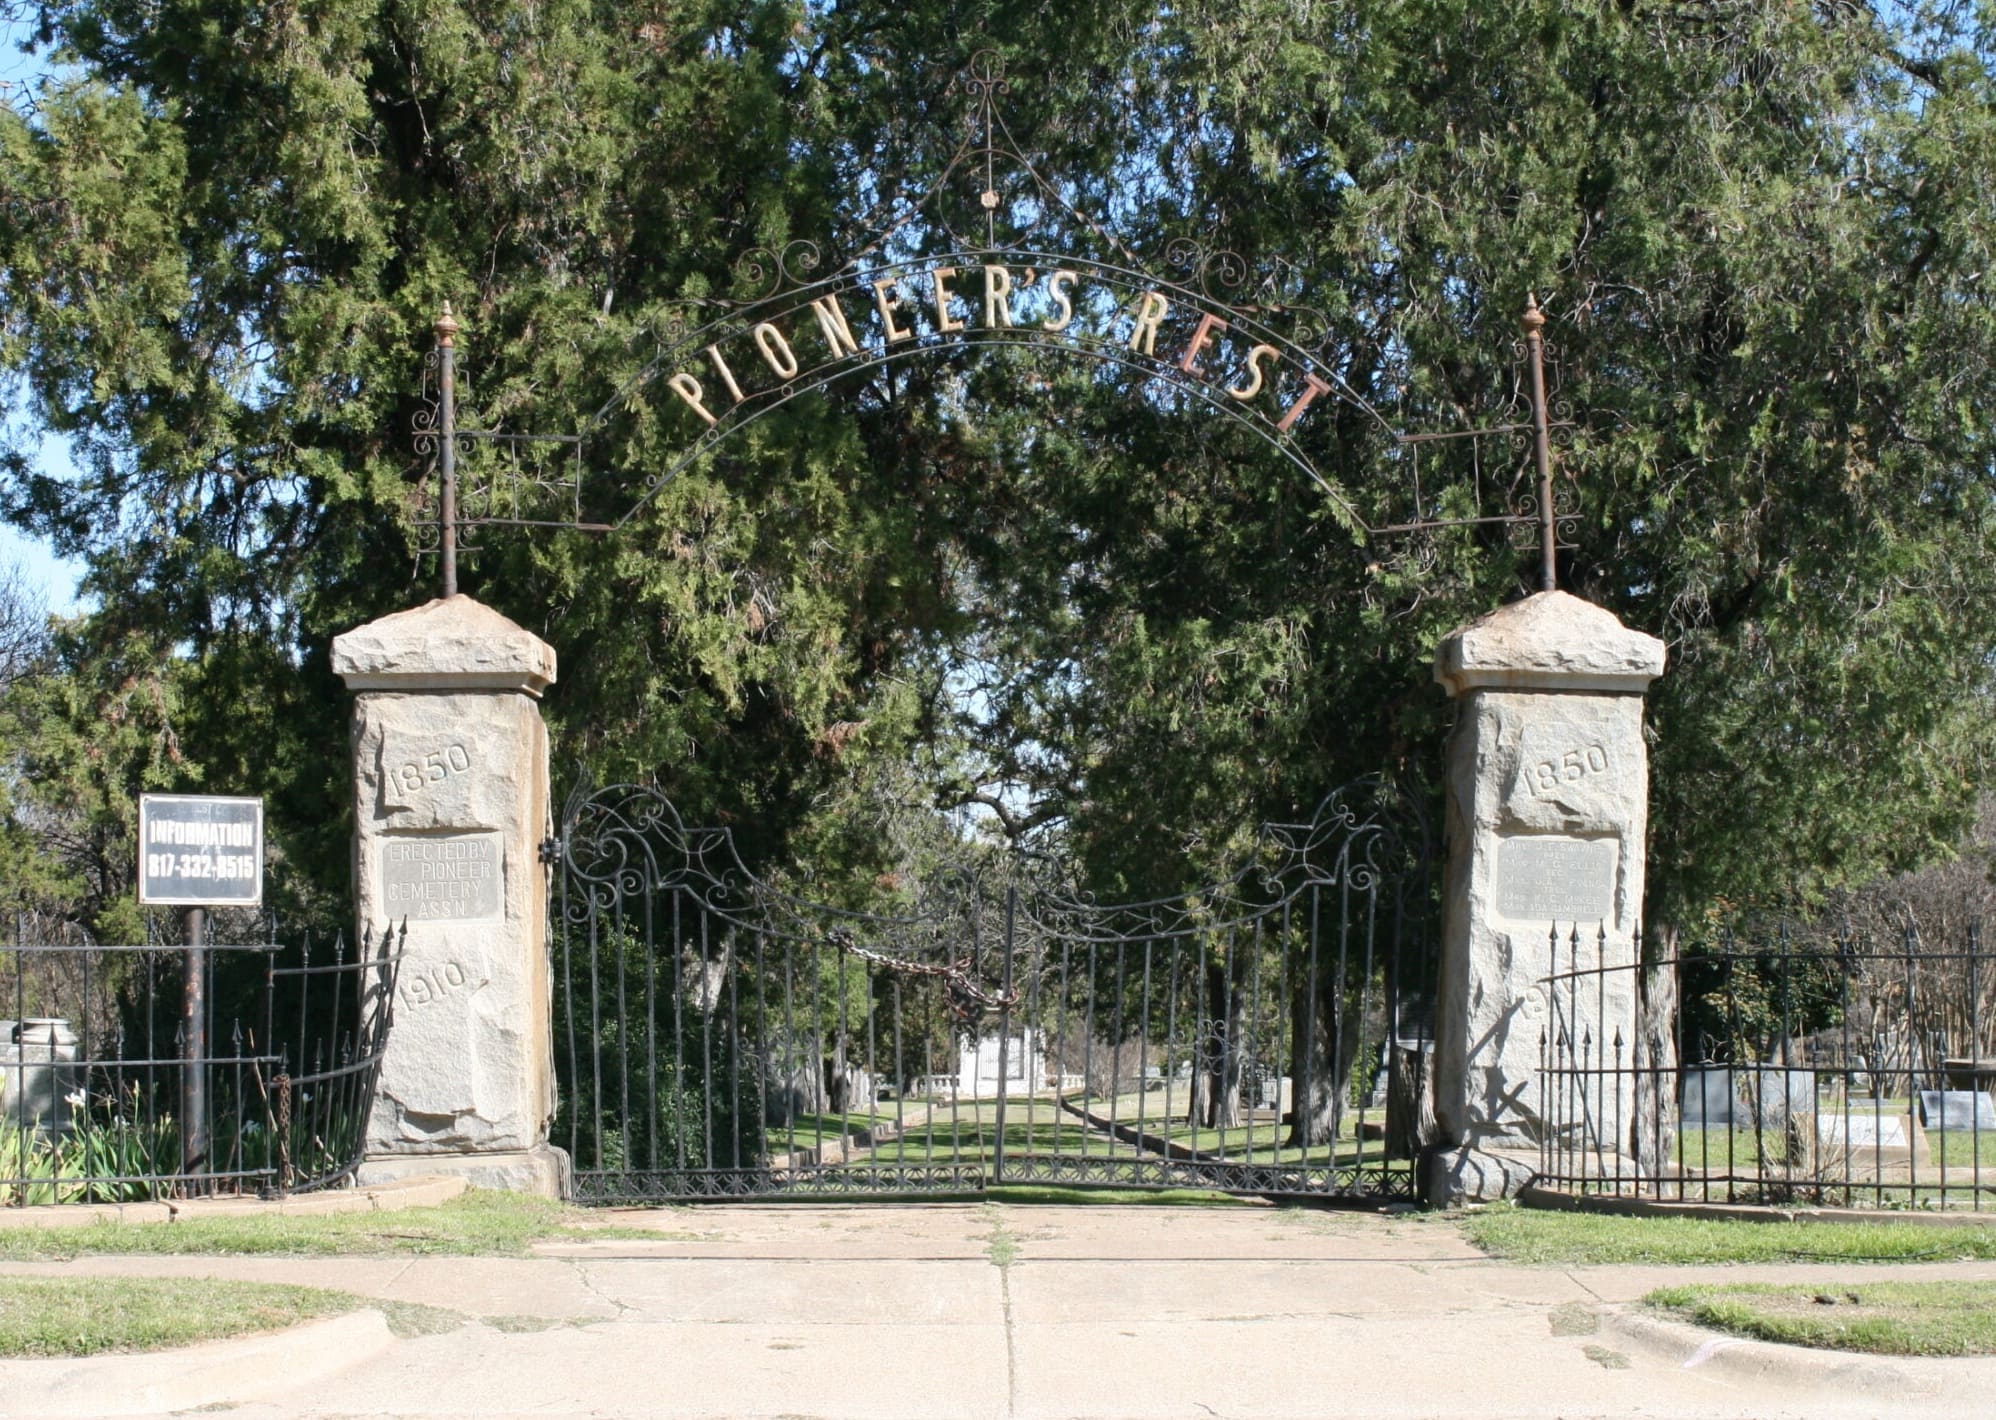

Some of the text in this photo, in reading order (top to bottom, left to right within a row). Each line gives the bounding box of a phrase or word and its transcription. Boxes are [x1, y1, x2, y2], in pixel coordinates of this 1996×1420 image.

[668, 264, 1332, 432] PIONEER'S REST
[391, 743, 471, 797] 1850
[1524, 744, 1608, 797] 1850
[150, 820, 253, 847] INFORMATION
[390, 839, 489, 862] ERECTED BY
[388, 879, 482, 901] CEMETERY
[421, 861, 491, 880] PIONEER
[399, 961, 465, 1012] 1910
